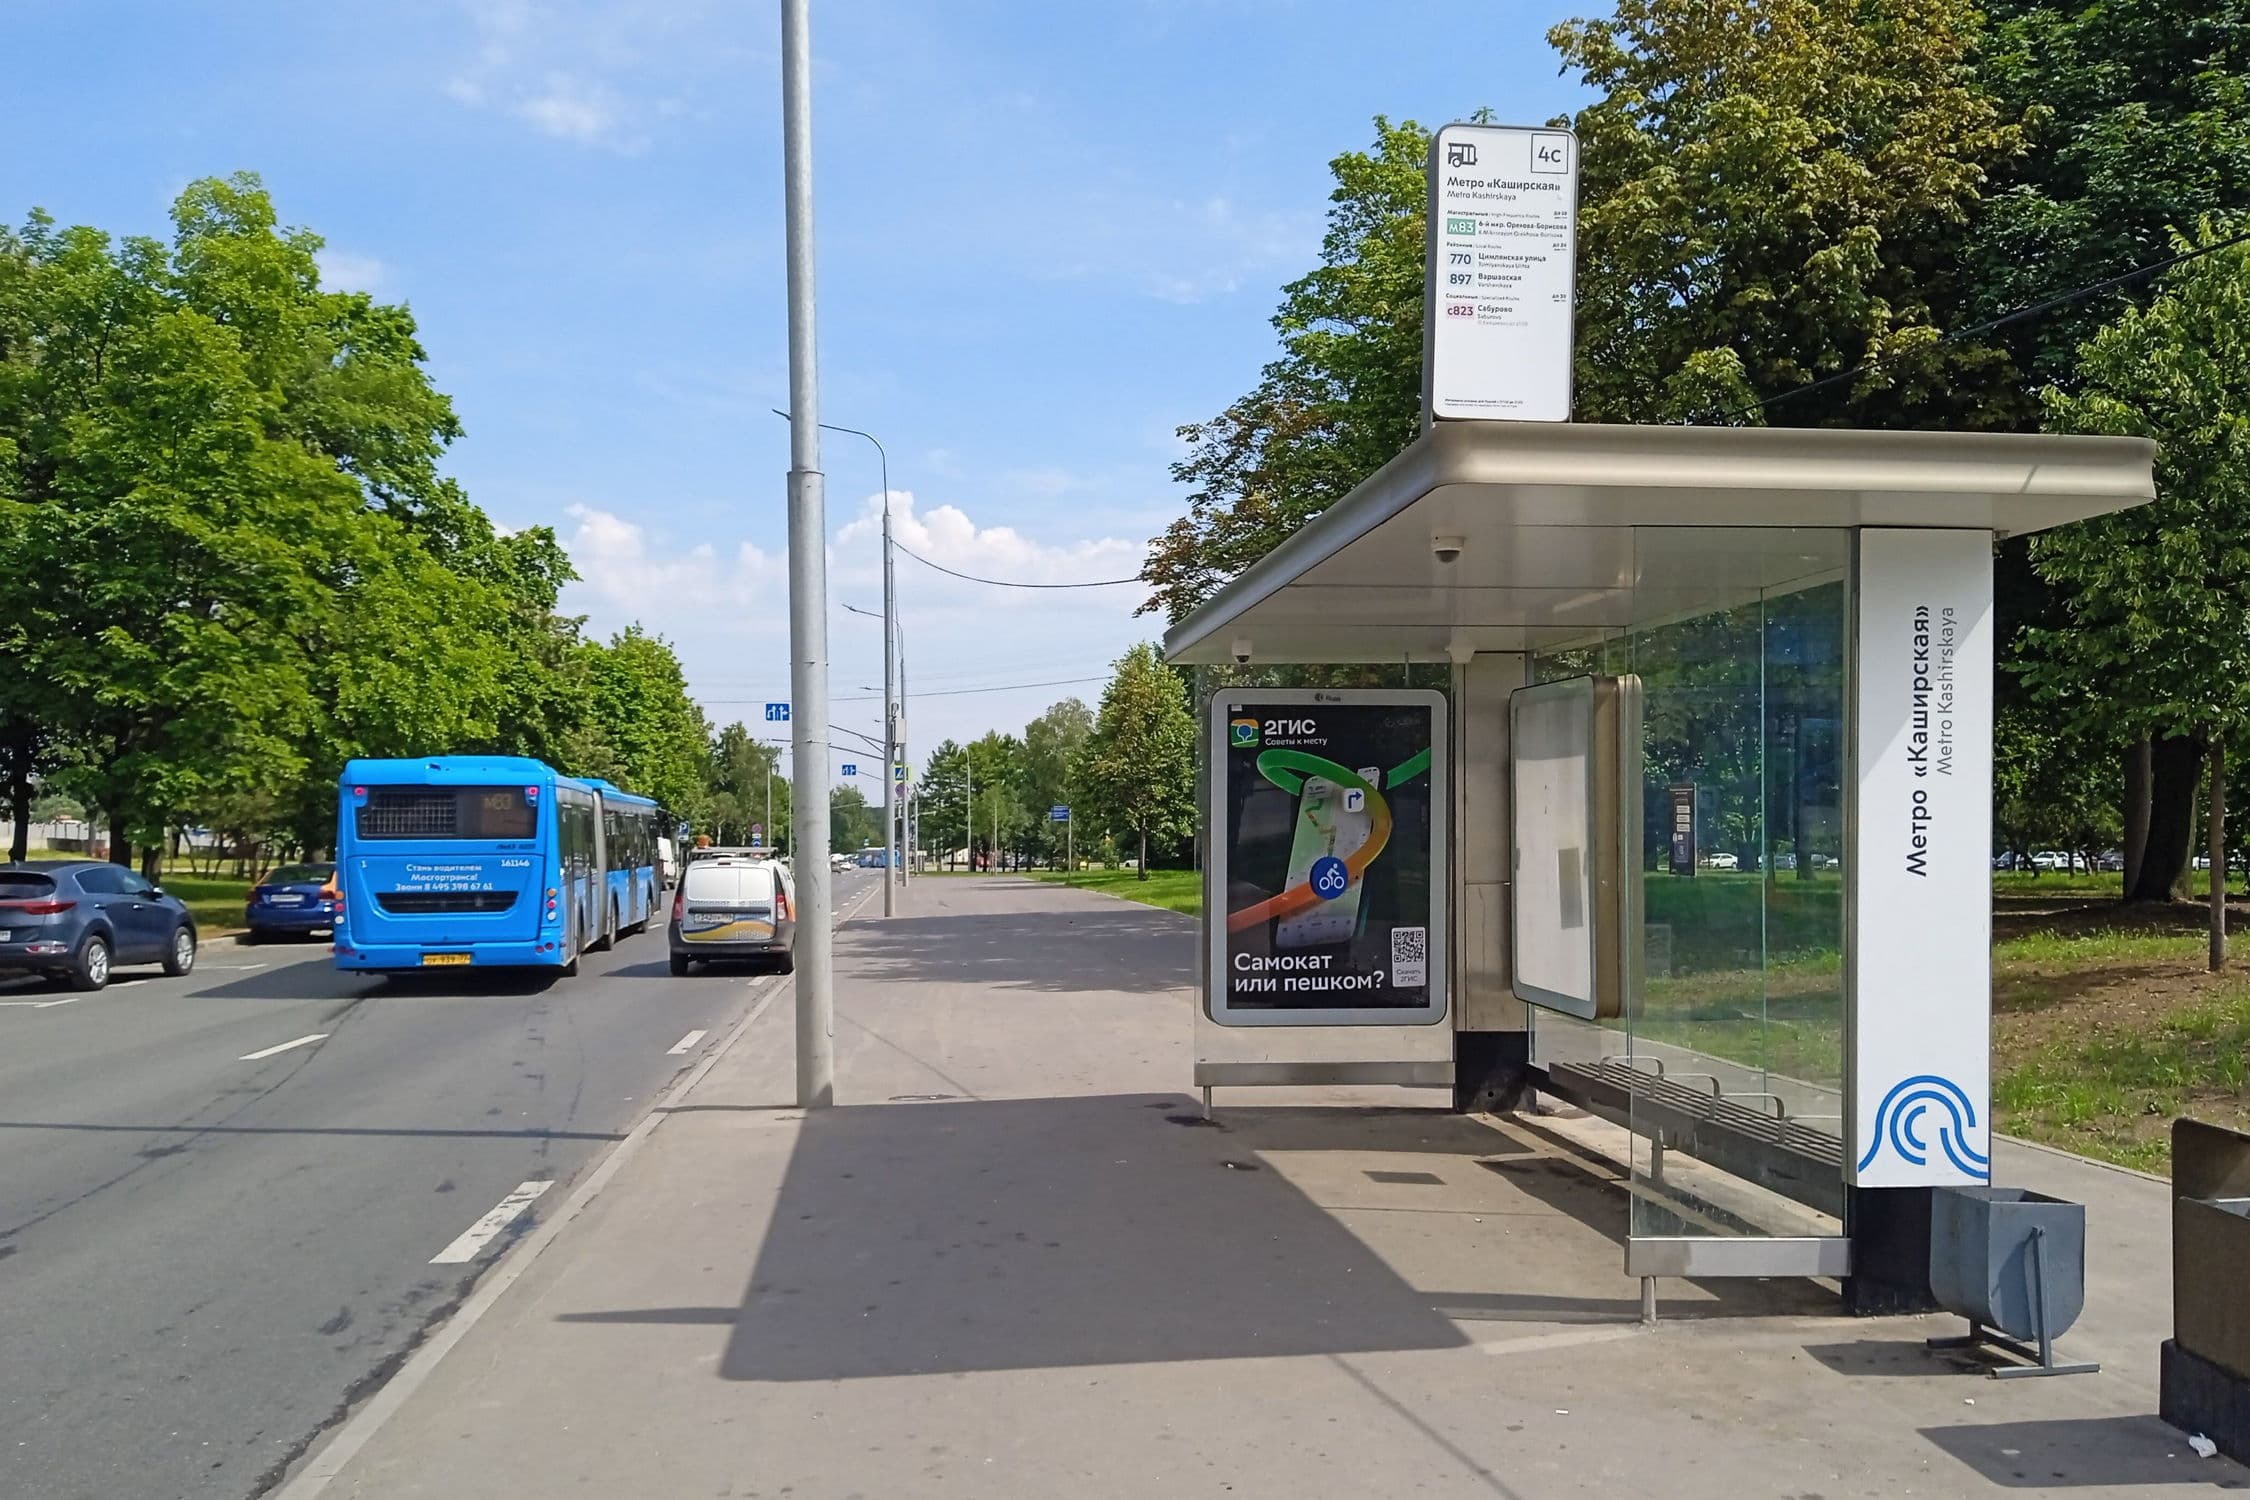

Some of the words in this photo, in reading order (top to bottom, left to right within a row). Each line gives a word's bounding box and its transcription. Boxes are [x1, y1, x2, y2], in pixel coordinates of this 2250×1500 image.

[1447, 177, 1485, 189] Метро
[1487, 179, 1560, 192] «Каширская»
[1447, 190, 1470, 198] Metro
[1472, 191, 1516, 202] Kashirskaya
[1448, 223, 1474, 233] м83
[1450, 254, 1471, 265] 770
[1478, 253, 1523, 261] Цимлянская
[1450, 274, 1472, 285] 897
[1447, 306, 1474, 316] с823
[1478, 305, 1512, 313] Сабурово
[1936, 606, 1958, 714] Kashirskaya
[1907, 605, 1933, 778] «Каширская»
[1264, 719, 1317, 736] 2ГИС
[1264, 738, 1296, 746] Советы
[1304, 738, 1328, 747] месту
[1936, 719, 1954, 776] Metro
[1906, 789, 1932, 877] Метро
[406, 864, 432, 872] Стань
[500, 859, 530, 868] 161146
[410, 874, 478, 882] Мосгортранса!
[1234, 952, 1333, 971] Самокат
[1234, 976, 1277, 992] или
[1284, 970, 1385, 992] пешком?
